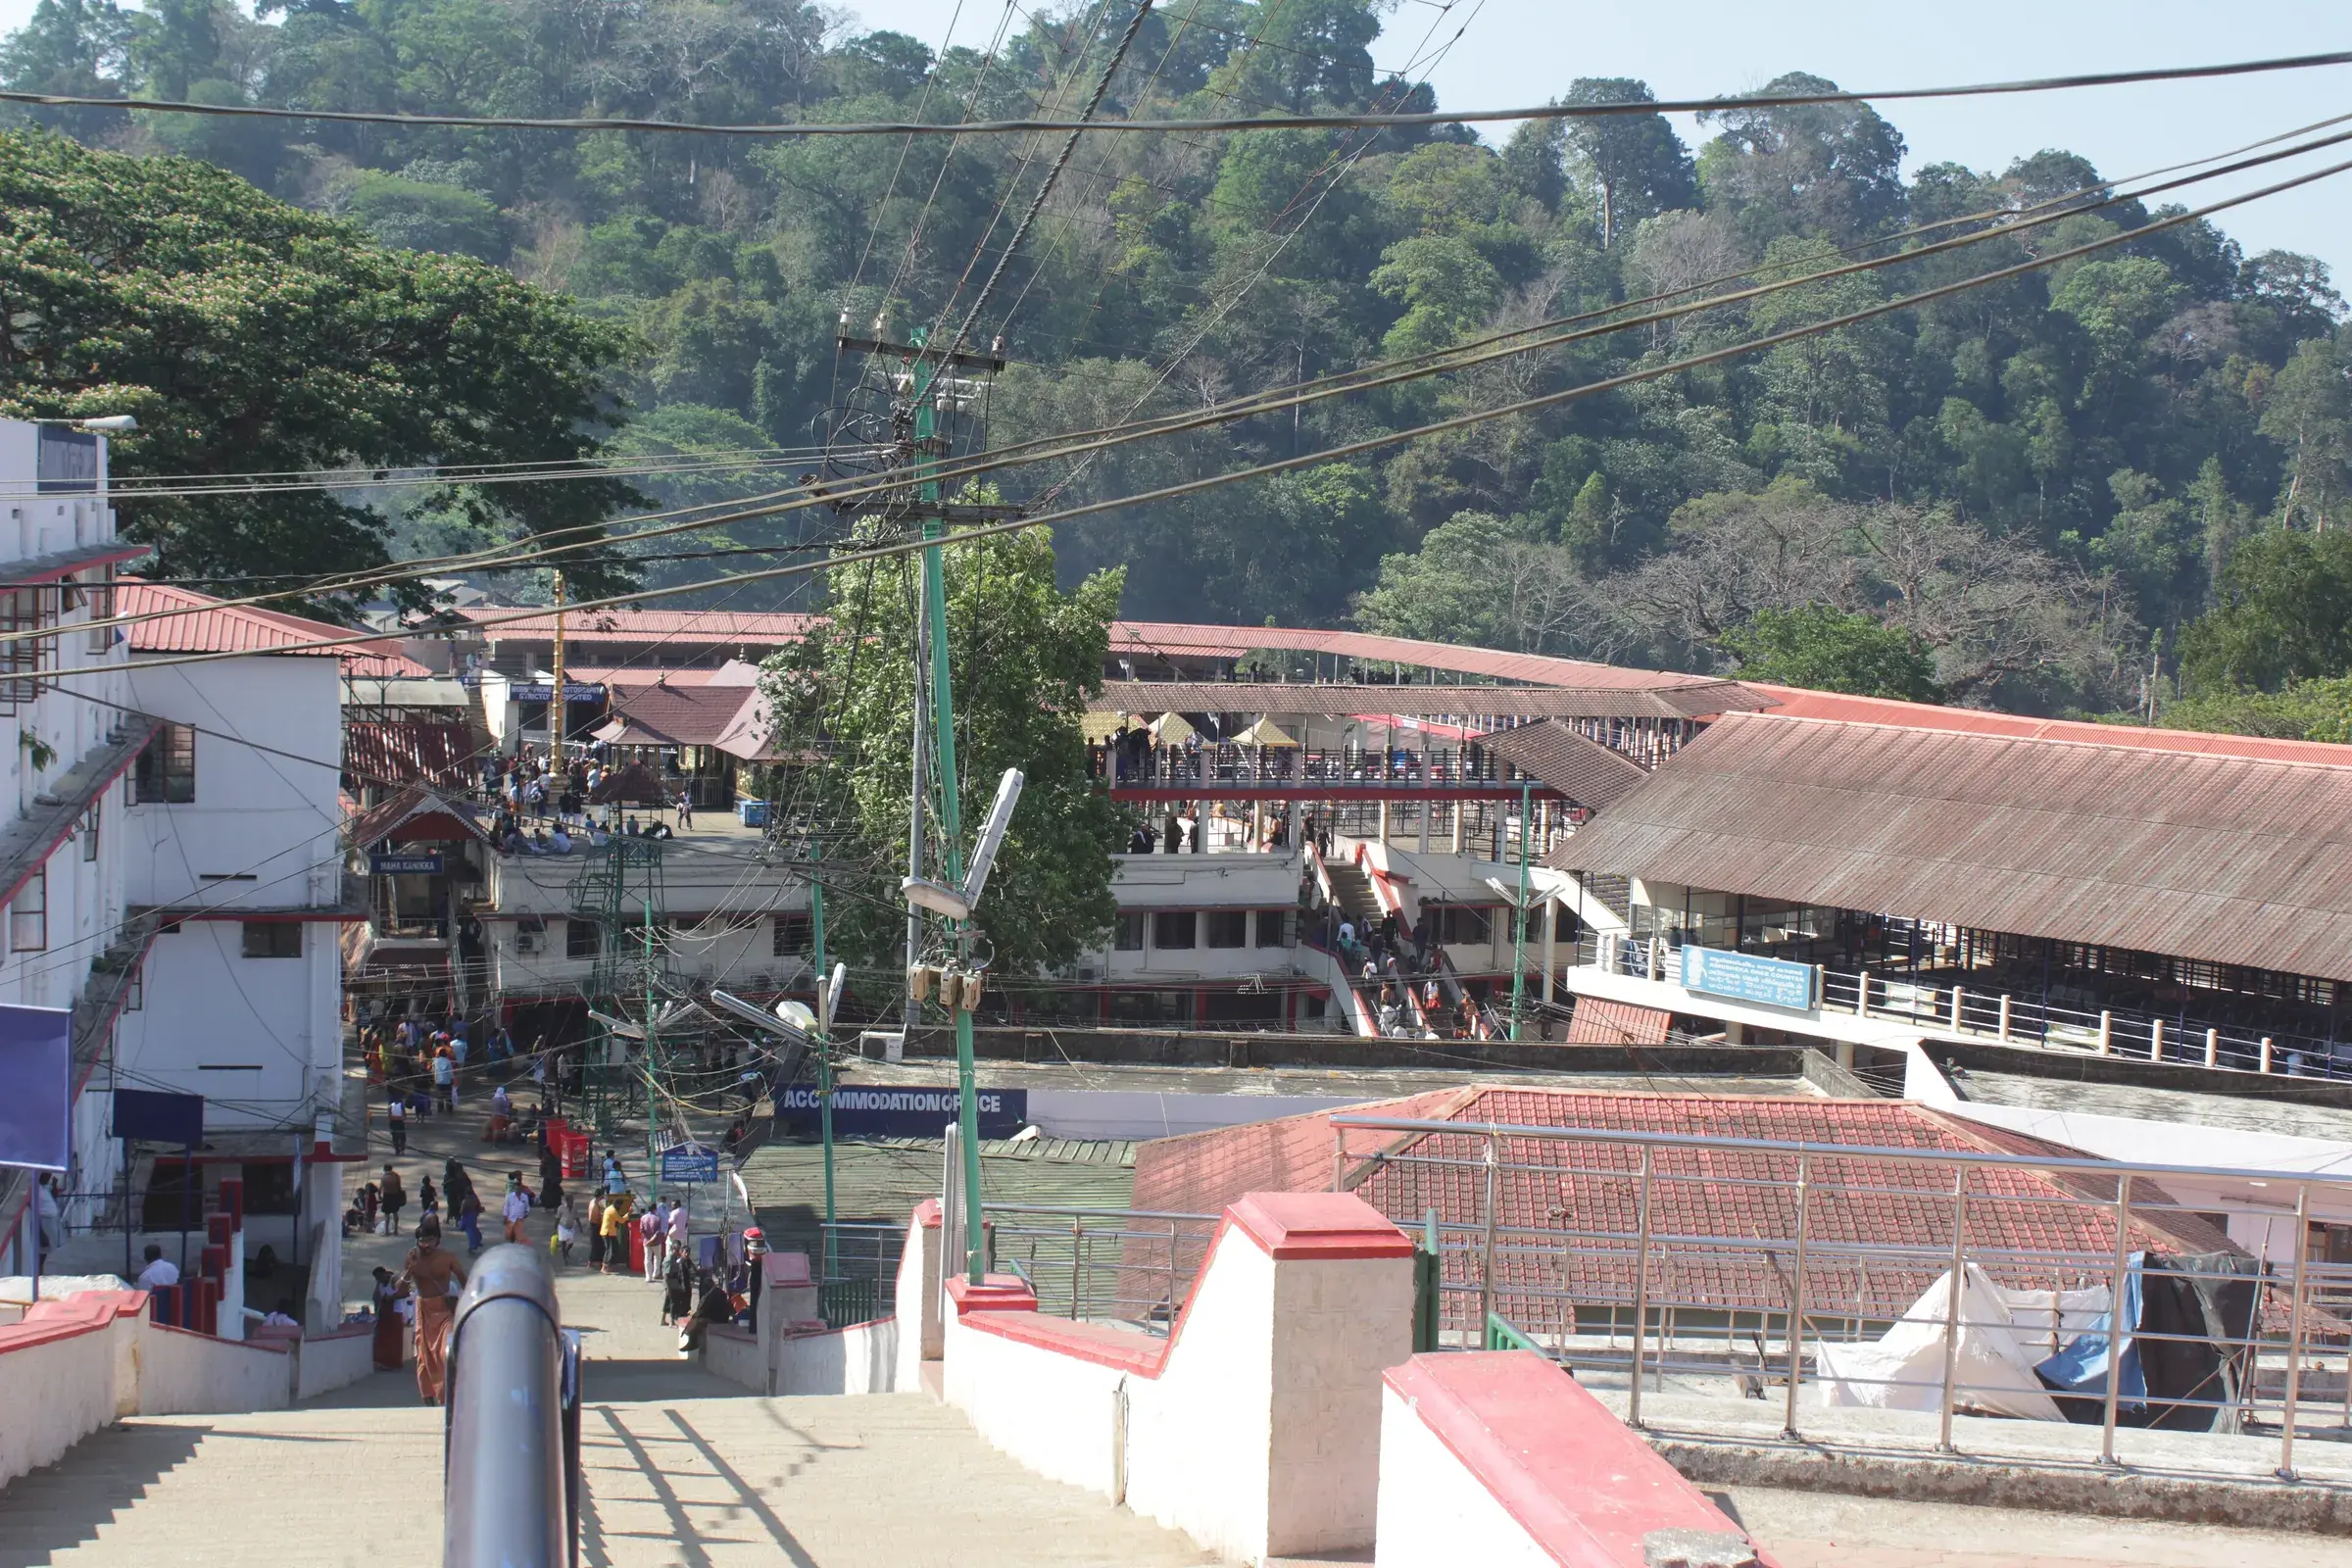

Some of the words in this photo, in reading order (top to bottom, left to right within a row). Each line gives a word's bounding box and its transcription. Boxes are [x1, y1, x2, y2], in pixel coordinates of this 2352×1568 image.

[380, 861, 401, 871] MAHA
[403, 861, 435, 871] KANIKKA
[1771, 972, 1804, 983] COUNTER
[784, 1090, 940, 1111] ACCMMODATION
[941, 1094, 1001, 1112] OFCE
